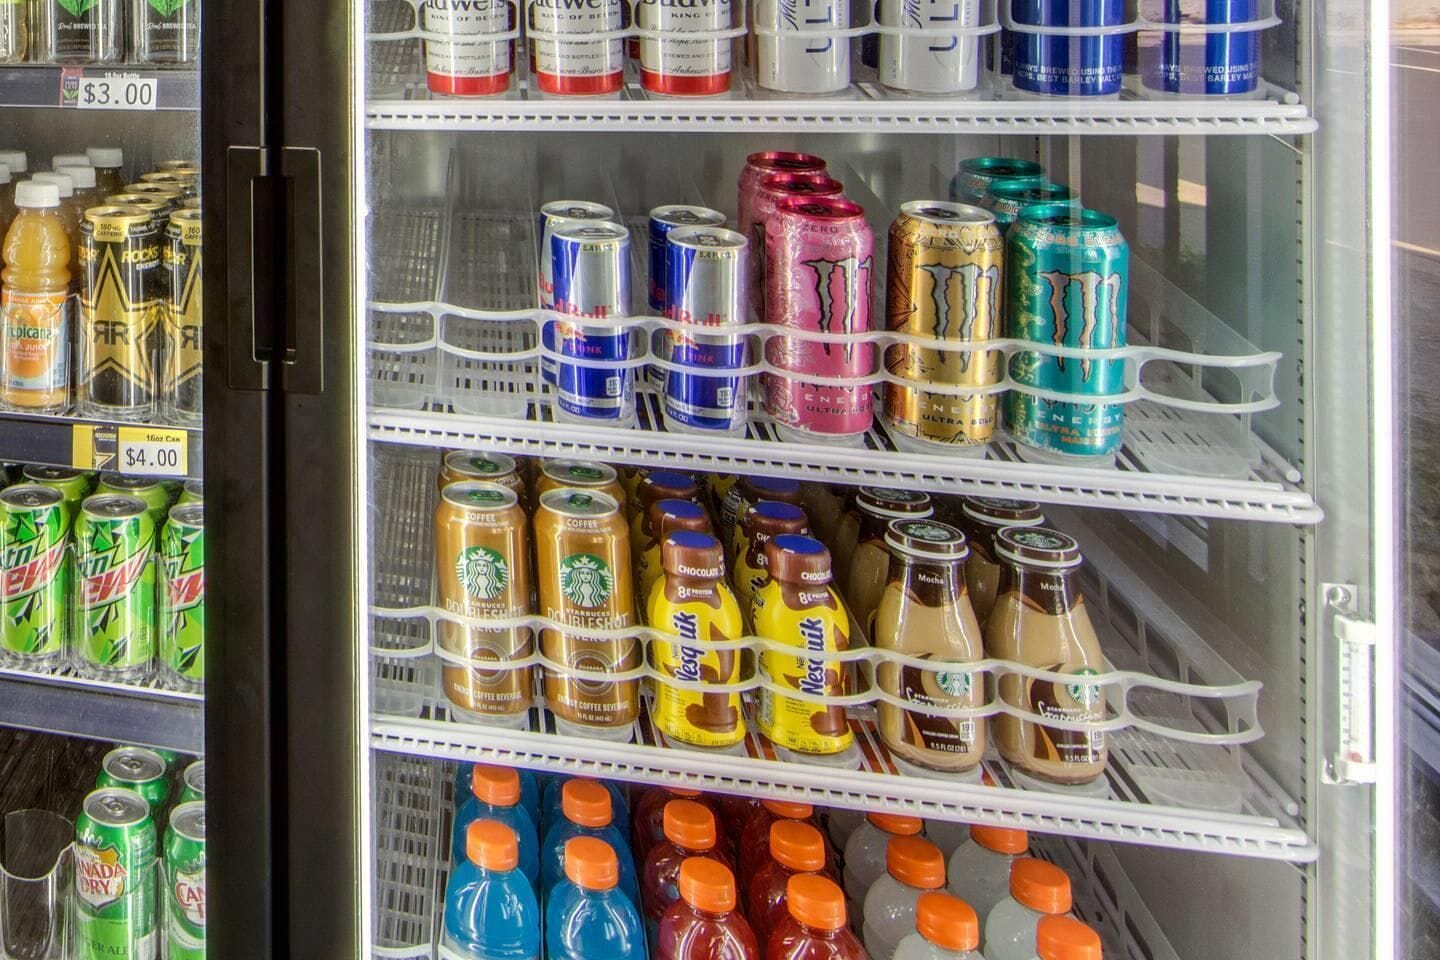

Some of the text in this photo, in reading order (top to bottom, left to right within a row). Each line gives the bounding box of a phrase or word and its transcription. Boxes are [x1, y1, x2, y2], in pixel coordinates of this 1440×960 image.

[456, 13, 470, 21] OF
[568, 13, 583, 21] OF
[671, 12, 701, 21] KING
[83, 82, 152, 105] $3.00
[801, 223, 839, 234] ZERO
[806, 404, 845, 415] ULTRA
[922, 413, 964, 426] ULTRA
[125, 448, 178, 468] $4.00
[464, 511, 496, 522] COFFEE
[566, 518, 599, 529] COFFEE
[677, 565, 719, 578] CHOCOLATE
[918, 573, 944, 586] Mocha
[1040, 581, 1065, 592] Mocha
[566, 607, 610, 617] STARBUCKS
[547, 607, 628, 630] DOUBLESHOT
[473, 692, 495, 702] COFFEE
[579, 702, 601, 712] COFFEE
